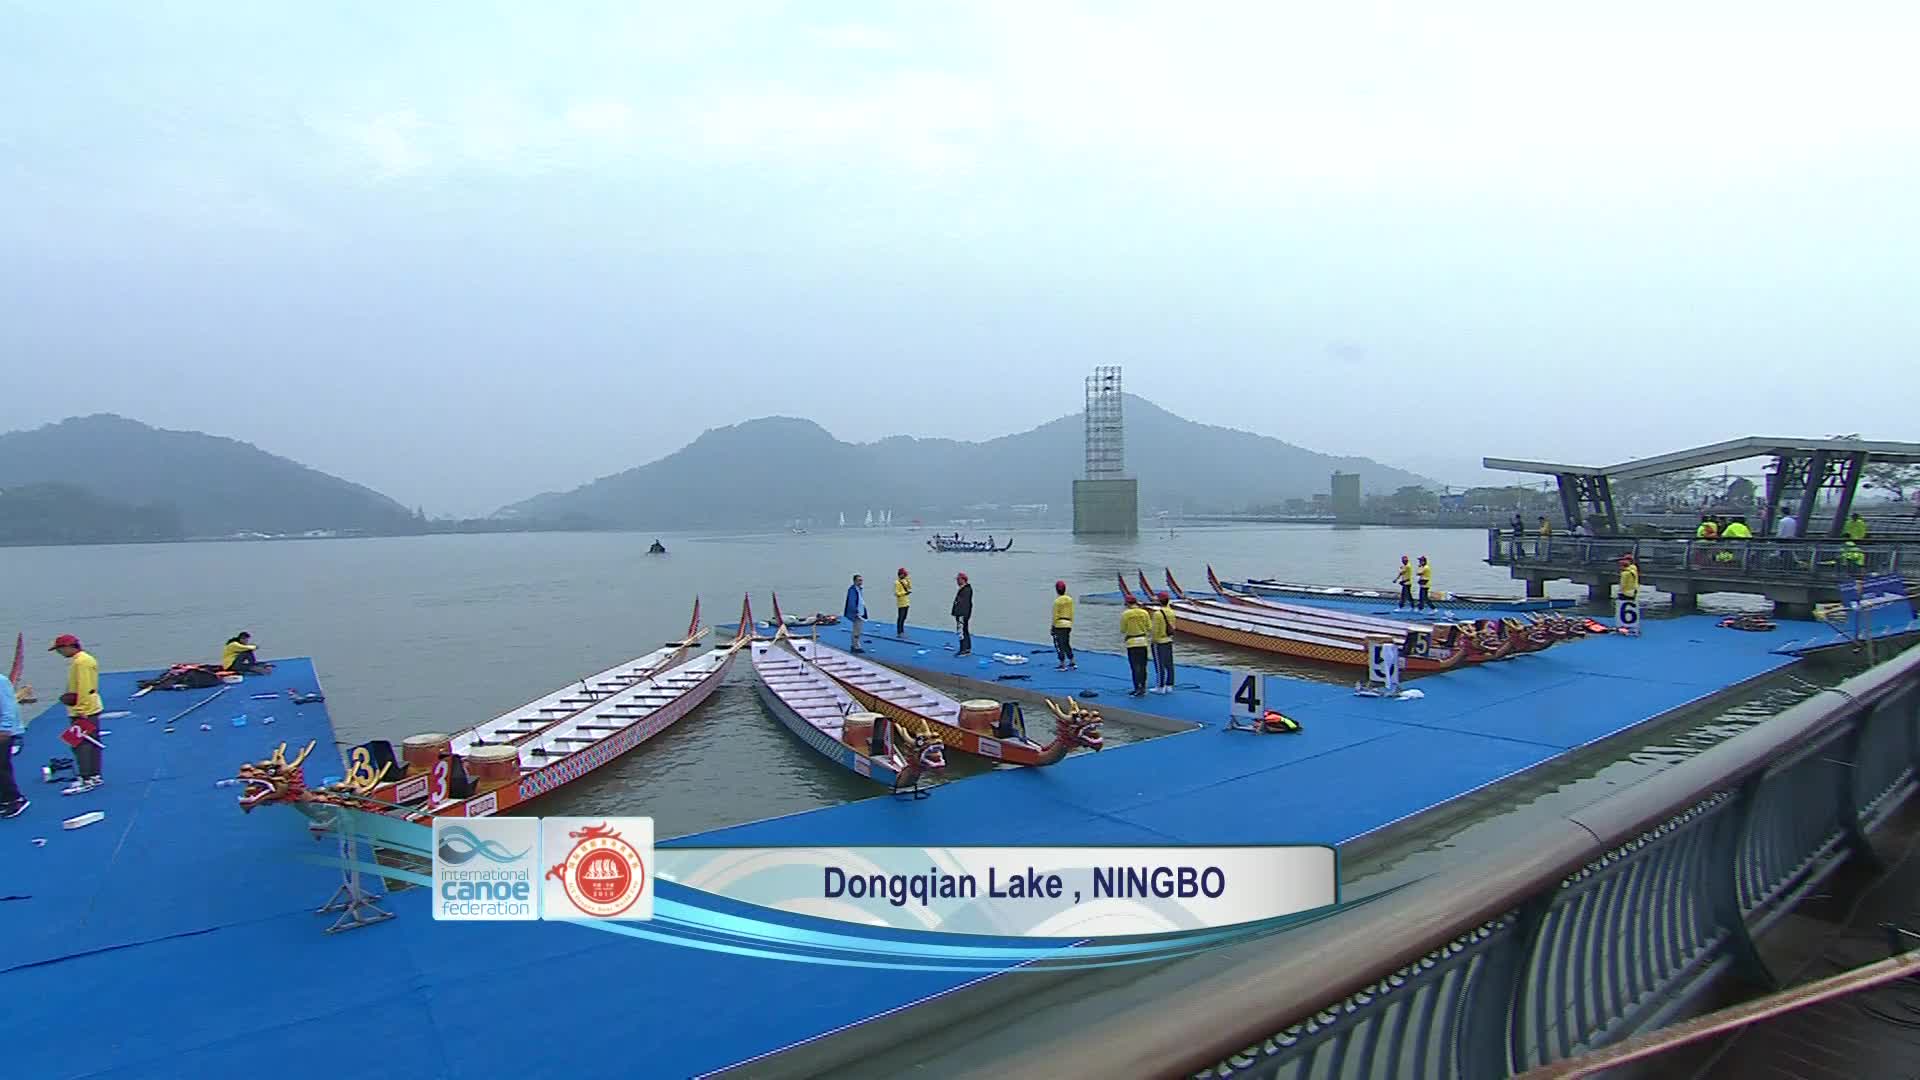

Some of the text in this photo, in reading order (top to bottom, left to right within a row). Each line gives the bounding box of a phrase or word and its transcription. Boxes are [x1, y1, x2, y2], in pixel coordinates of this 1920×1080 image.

[1619, 602, 1638, 624] 6
[1416, 632, 1428, 654] 5
[1234, 674, 1261, 713] 4
[353, 747, 373, 787] 3
[431, 760, 448, 804] 3
